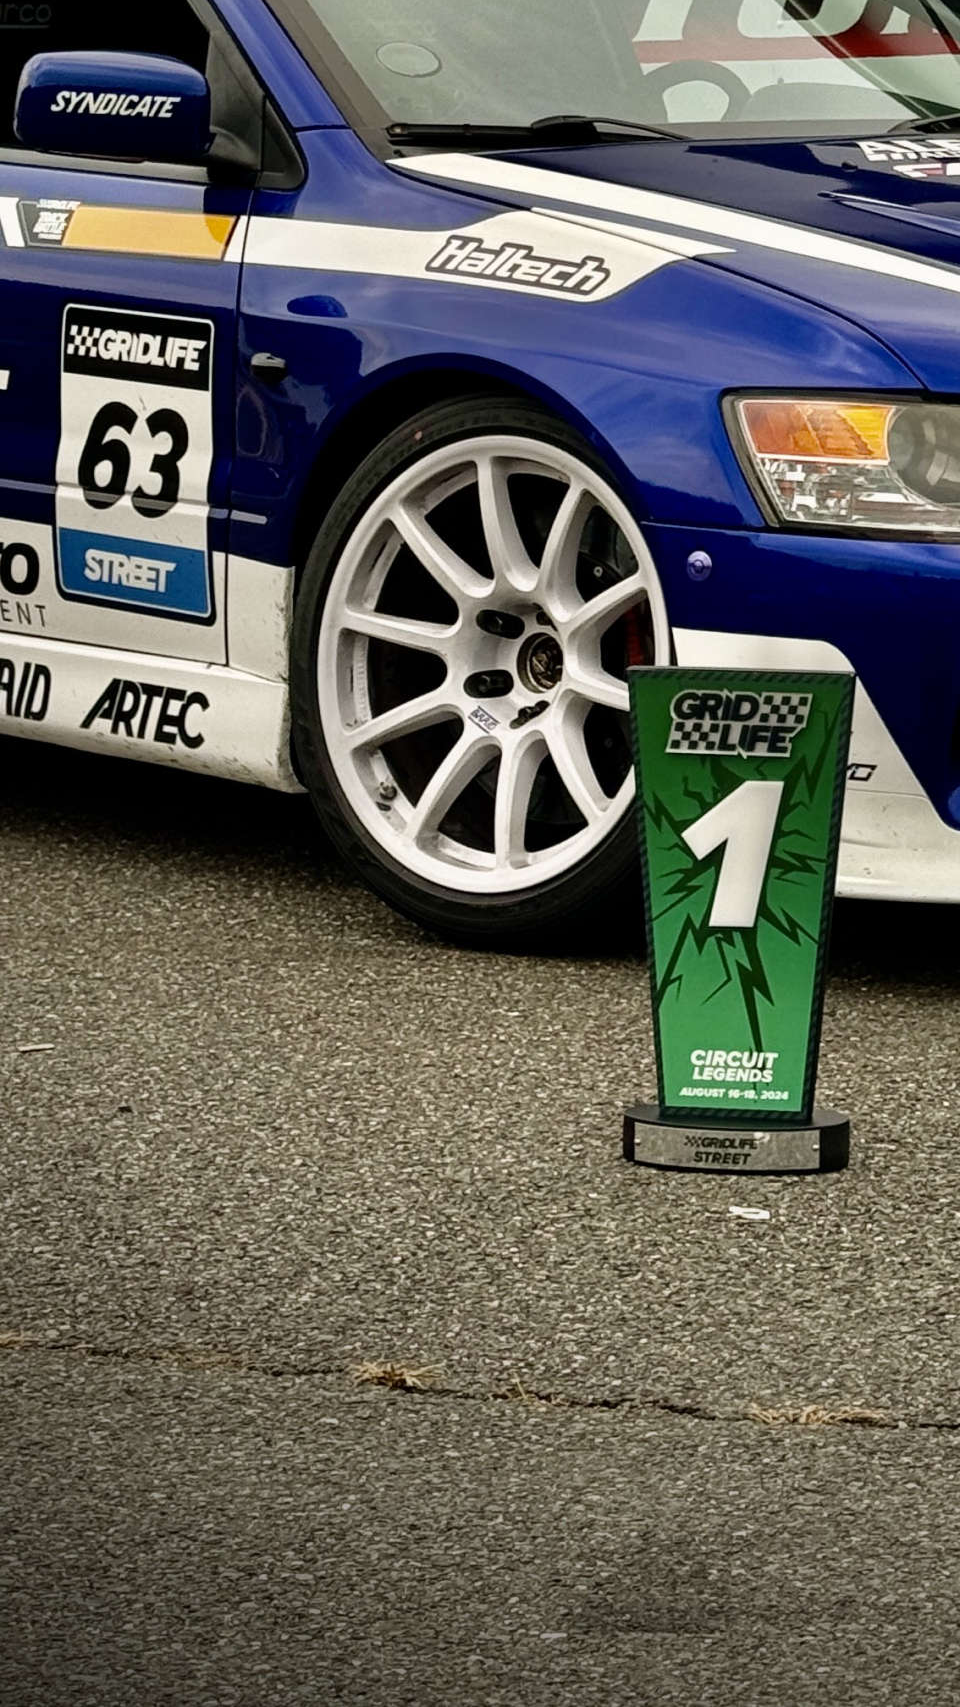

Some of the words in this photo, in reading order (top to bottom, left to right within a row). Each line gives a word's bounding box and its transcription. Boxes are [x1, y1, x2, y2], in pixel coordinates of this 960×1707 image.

[50, 91, 181, 118] SYNDICATE
[427, 236, 609, 294] Haltech
[98, 329, 207, 371] GRIDLIFE
[78, 401, 189, 518] 63
[84, 548, 176, 593] STREET
[80, 677, 210, 749] ARTEC
[673, 690, 760, 722] GRID
[717, 723, 800, 754] LIFE
[680, 780, 786, 928] 1
[690, 1050, 779, 1069] CIRCUIT
[692, 1067, 774, 1083] LEGENDS
[679, 1087, 726, 1098] AUGUST
[760, 1090, 790, 1101] 2024
[694, 1151, 751, 1166] STREET
